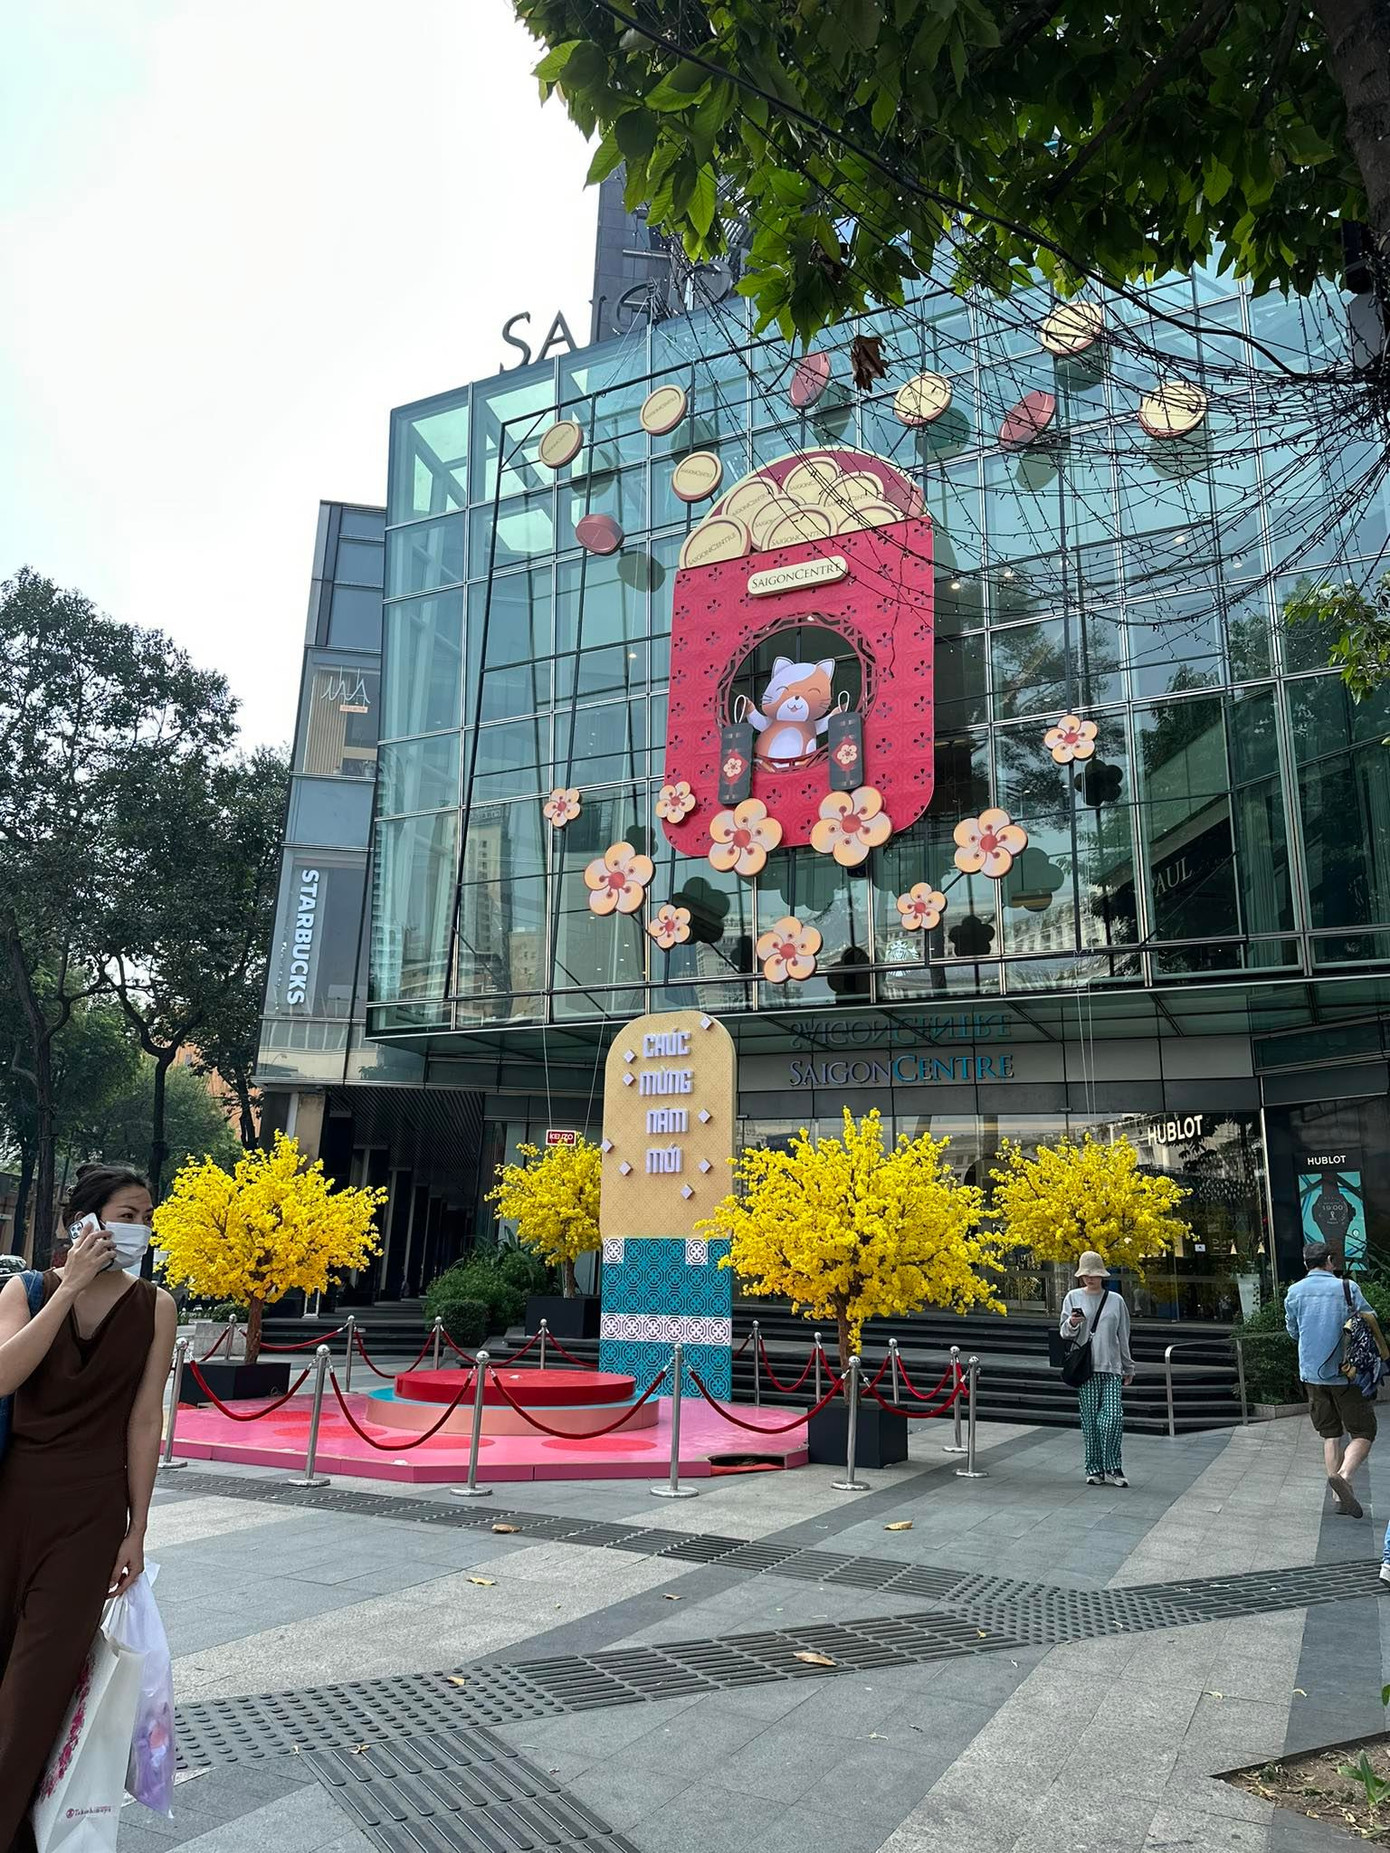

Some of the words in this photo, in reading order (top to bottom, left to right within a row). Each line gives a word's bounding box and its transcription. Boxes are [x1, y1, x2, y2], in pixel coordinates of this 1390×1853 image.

[751, 562, 842, 589] SAIGONCENTRE
[286, 868, 321, 1006] STARBUCKS
[643, 1027, 691, 1057] CHÚC
[789, 1053, 1015, 1086] SAIGONCENTRE
[646, 1106, 689, 1134] NĂM
[1147, 1114, 1203, 1146] HUBLOT
[645, 1142, 683, 1174] MỚI
[1307, 1155, 1346, 1165] HUBLOT
